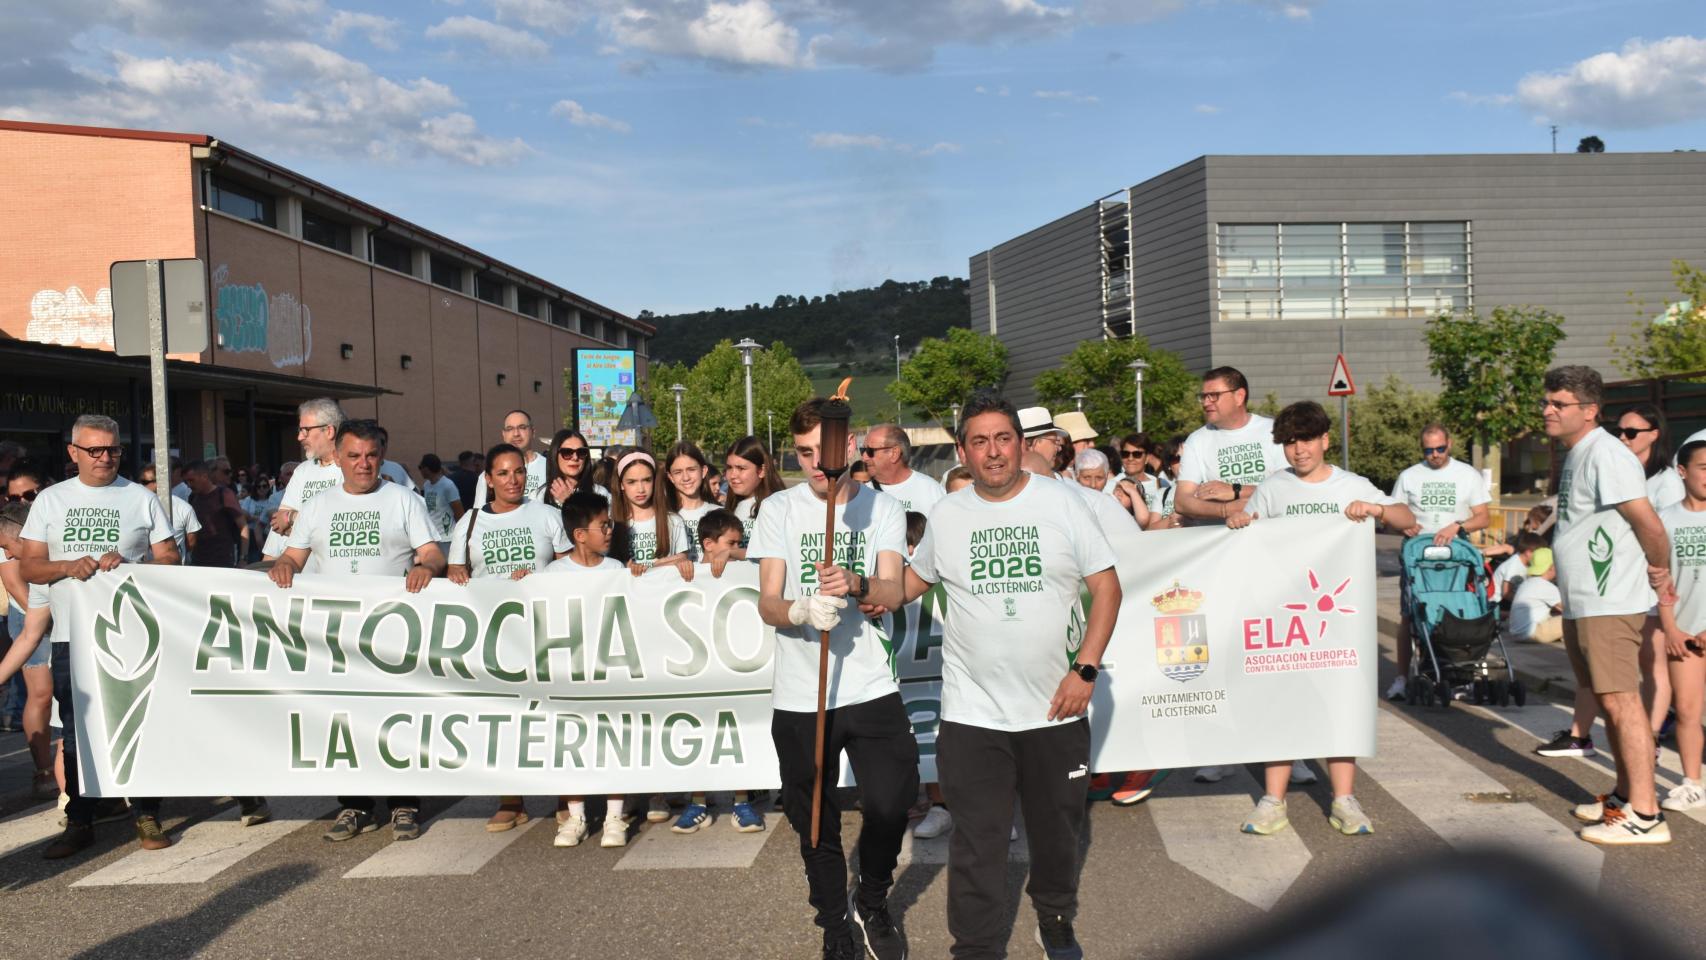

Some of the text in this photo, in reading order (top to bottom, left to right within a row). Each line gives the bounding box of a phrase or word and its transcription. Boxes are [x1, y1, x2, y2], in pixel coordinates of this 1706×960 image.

[1217, 442, 1262, 456] ANTORCHA
[1217, 450, 1264, 466] SOLIDARIA
[1219, 460, 1266, 478] 2026
[1420, 496, 1456, 506] 2026
[66, 508, 120, 519] ANTORCHA
[1286, 502, 1340, 516] ANTORCHA
[64, 518, 120, 528] SOLIDARIA
[332, 511, 380, 522] ANTORCHA
[330, 520, 380, 532] SOLIDARIA
[63, 528, 120, 542] 2026
[330, 530, 380, 546] 2026
[482, 527, 532, 540] ANTORCHA
[800, 532, 866, 547] ANTRCHA
[970, 526, 1040, 544] ANTORCHA
[64, 545, 72, 553] LA
[482, 536, 534, 550] SOLIDARIA
[970, 541, 1040, 559] SOLIDARIA
[330, 548, 338, 558] LA
[483, 546, 536, 565] 2026
[800, 547, 865, 562] SOLDARIA
[1675, 544, 1706, 557] 202
[487, 566, 495, 574] LA
[970, 556, 1042, 580] 2026
[972, 584, 984, 596] LA
[194, 594, 643, 683] ANTORCHA
[1244, 616, 1310, 650] ELA
[1310, 649, 1357, 661] EUROPEA
[1245, 665, 1275, 673] CONTRA
[1142, 690, 1226, 705] AYUNTAMIENTO DE
[1152, 708, 1163, 718] LA
[289, 700, 745, 770] LA CISTÉRNIGA
